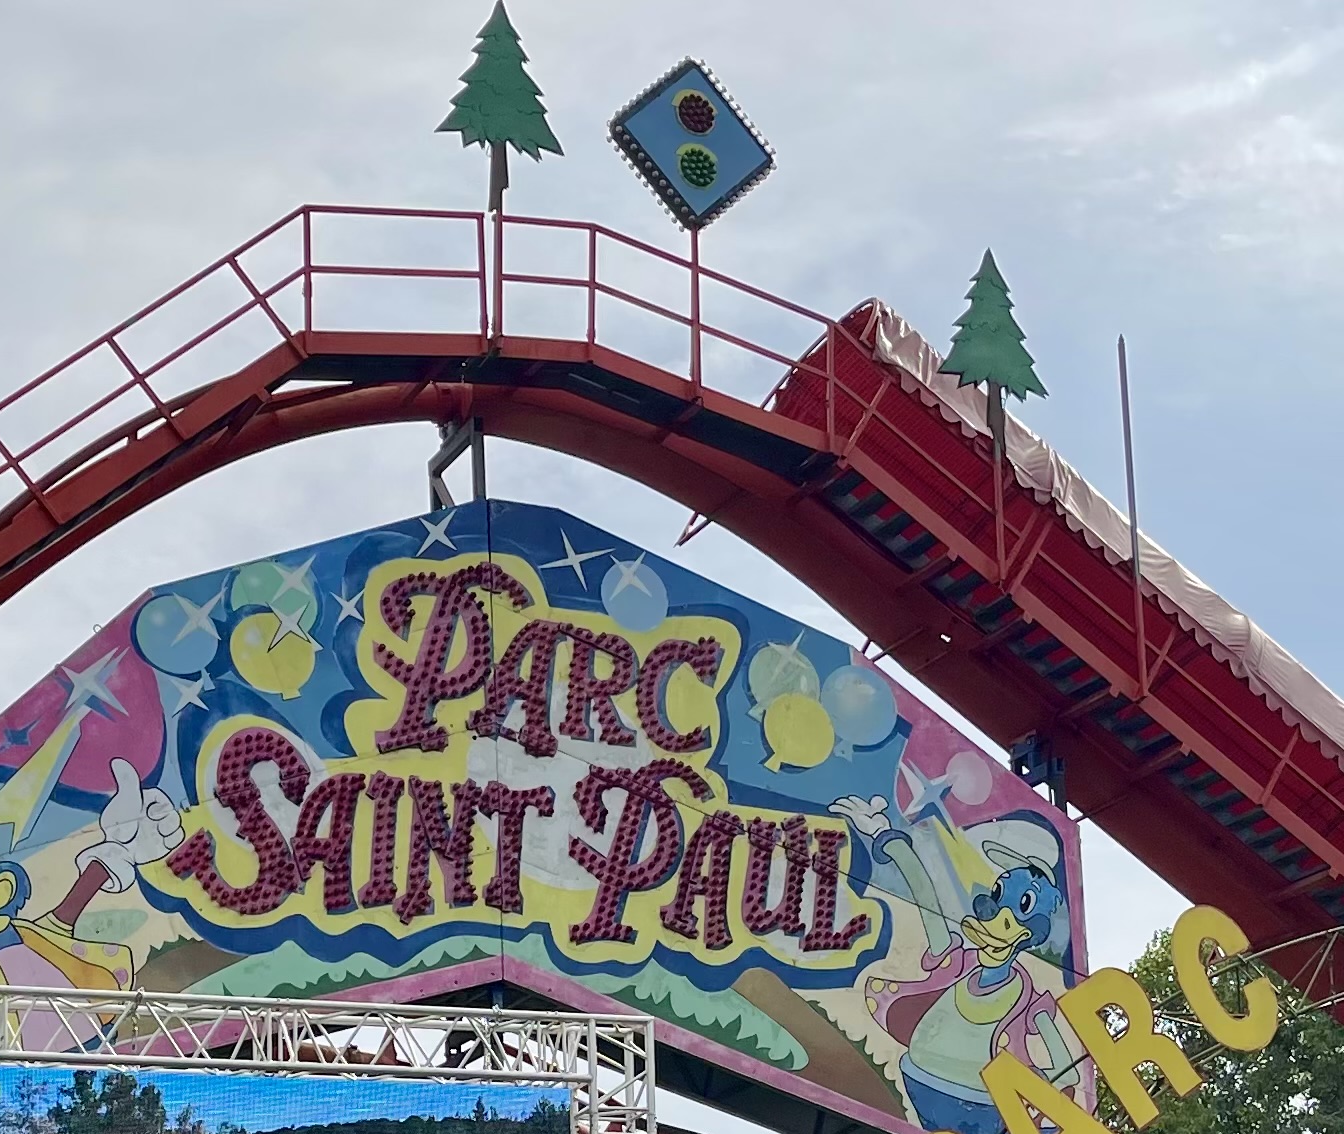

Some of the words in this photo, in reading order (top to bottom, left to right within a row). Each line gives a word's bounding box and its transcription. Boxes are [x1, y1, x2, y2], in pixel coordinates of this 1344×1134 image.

[373, 560, 723, 758] PARC
[166, 728, 555, 924] SAINT
[567, 762, 872, 954] PAUL
